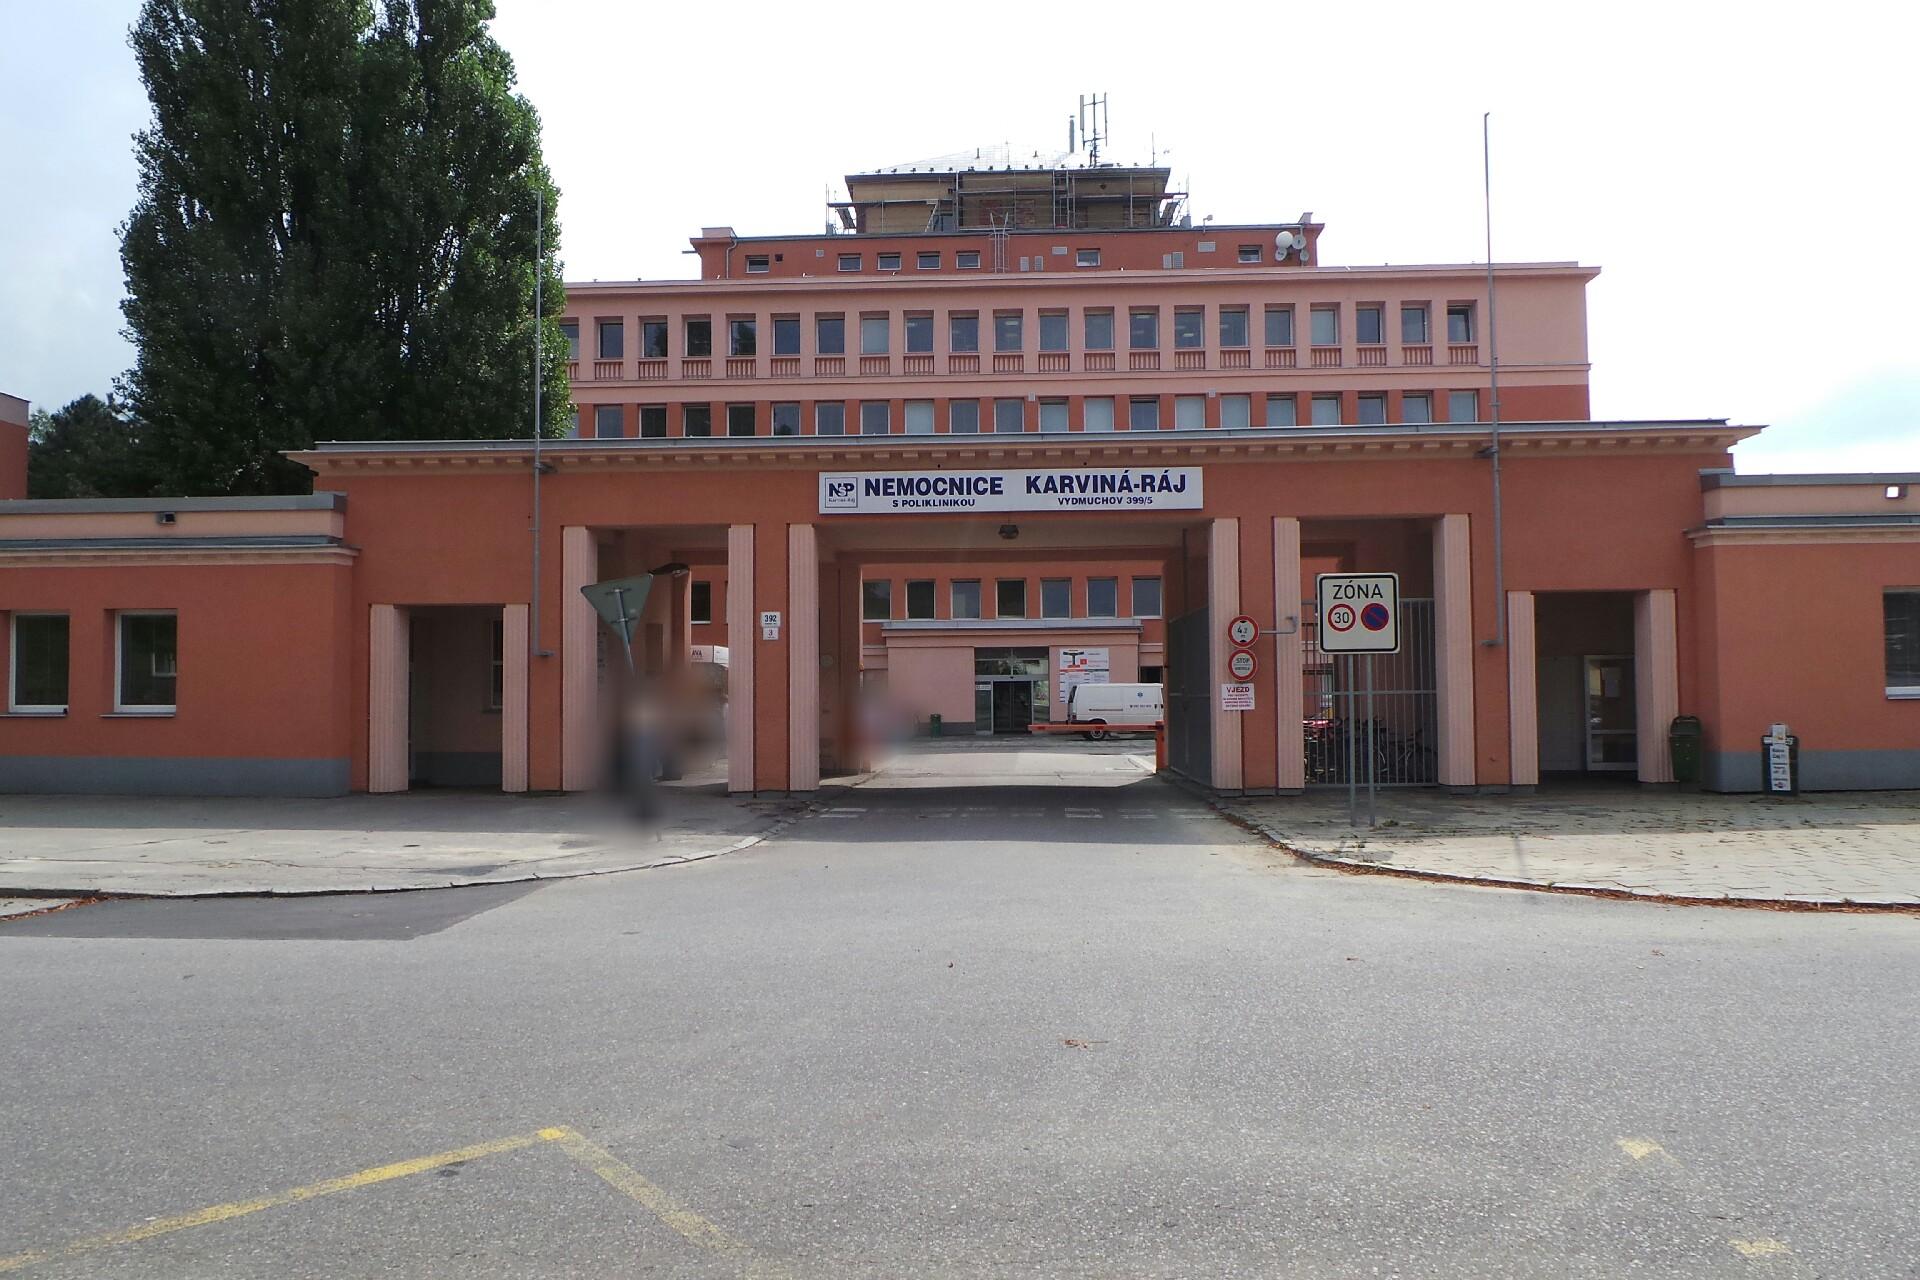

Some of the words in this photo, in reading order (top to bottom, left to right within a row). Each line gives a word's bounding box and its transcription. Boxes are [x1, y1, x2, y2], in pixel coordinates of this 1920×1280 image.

[864, 476, 1004, 497] NEMOCNICE
[1025, 469, 1187, 494] KARVINÁ-RÁJ
[892, 499, 899, 508] S
[901, 498, 976, 508] POLIKLINIKOU
[1057, 496, 1124, 506] VYDMUCHOV
[1126, 496, 1153, 506] 399/5
[1332, 579, 1384, 600] ZÓNA
[764, 614, 777, 623] 392
[1334, 611, 1350, 624] 30
[1226, 685, 1250, 693] VJEZD
